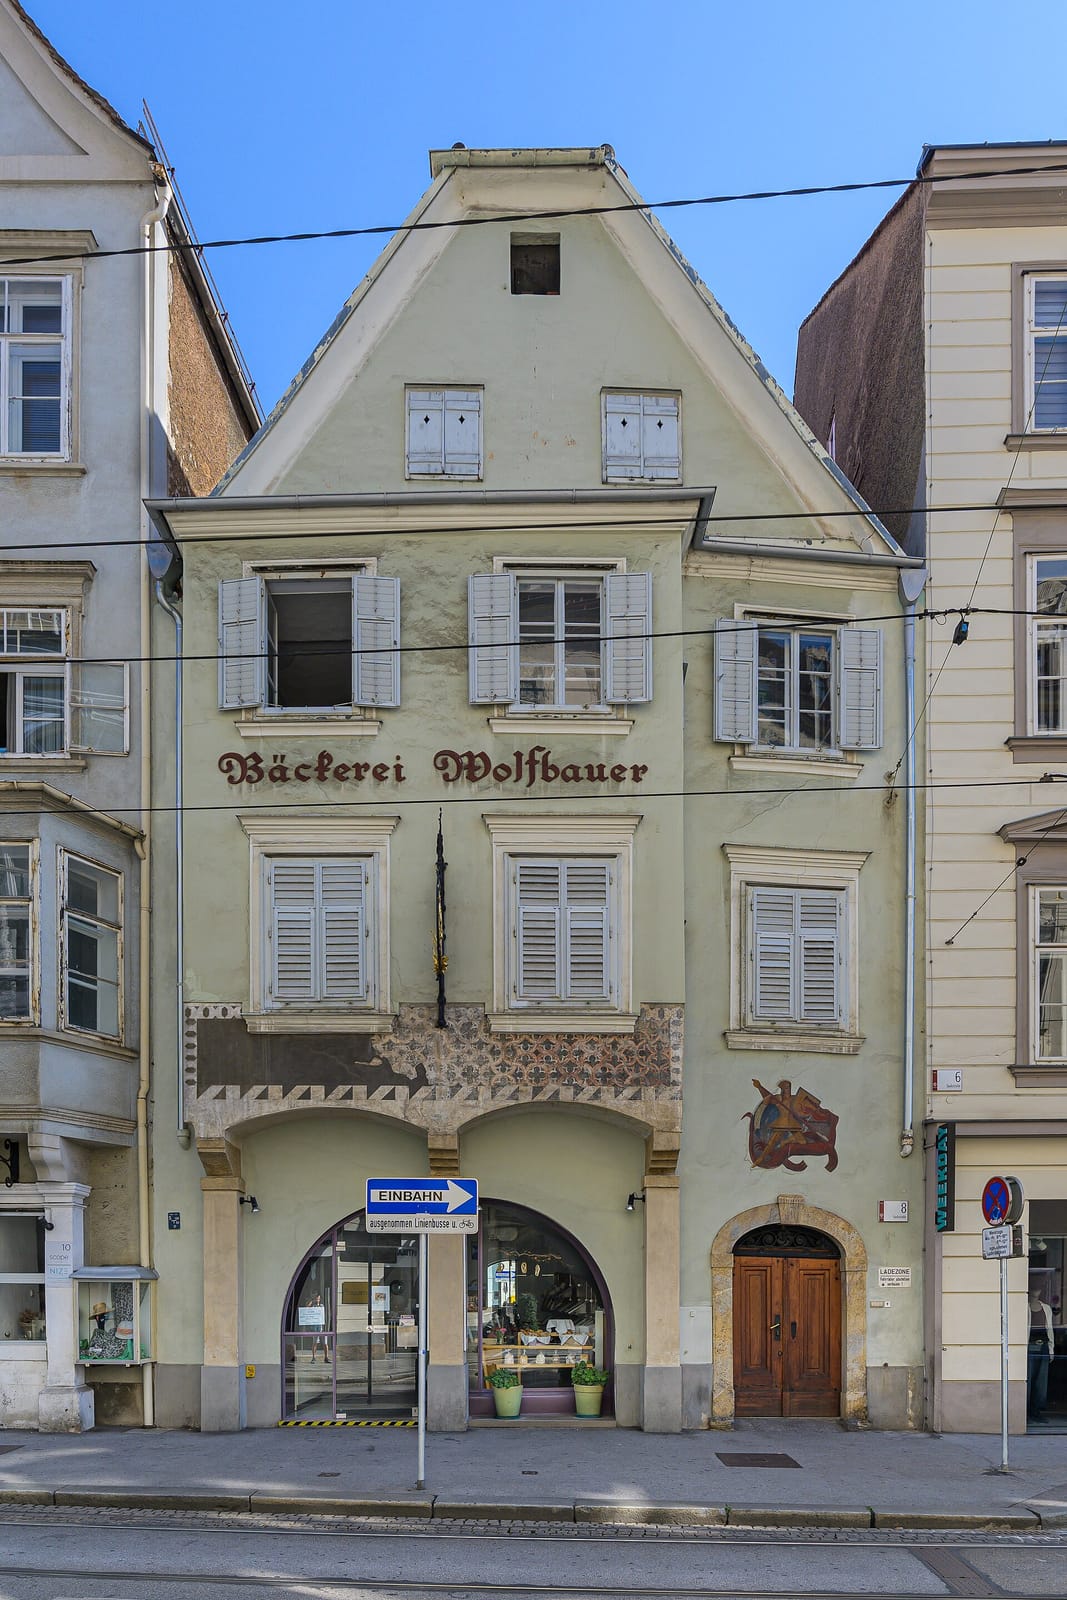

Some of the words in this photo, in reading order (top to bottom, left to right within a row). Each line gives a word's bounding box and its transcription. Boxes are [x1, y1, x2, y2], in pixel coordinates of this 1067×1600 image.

[217, 750, 406, 784] Bäckerei
[433, 745, 648, 788] Wolfbauer
[955, 1071, 961, 1083] 6
[936, 1125, 948, 1231] WEEKDAY
[379, 1191, 443, 1201] EINBAHN
[901, 1202, 907, 1213] 8
[369, 1220, 413, 1230] ausgenommen
[414, 1218, 450, 1228] Linienbusse
[62, 1243, 71, 1251] 10
